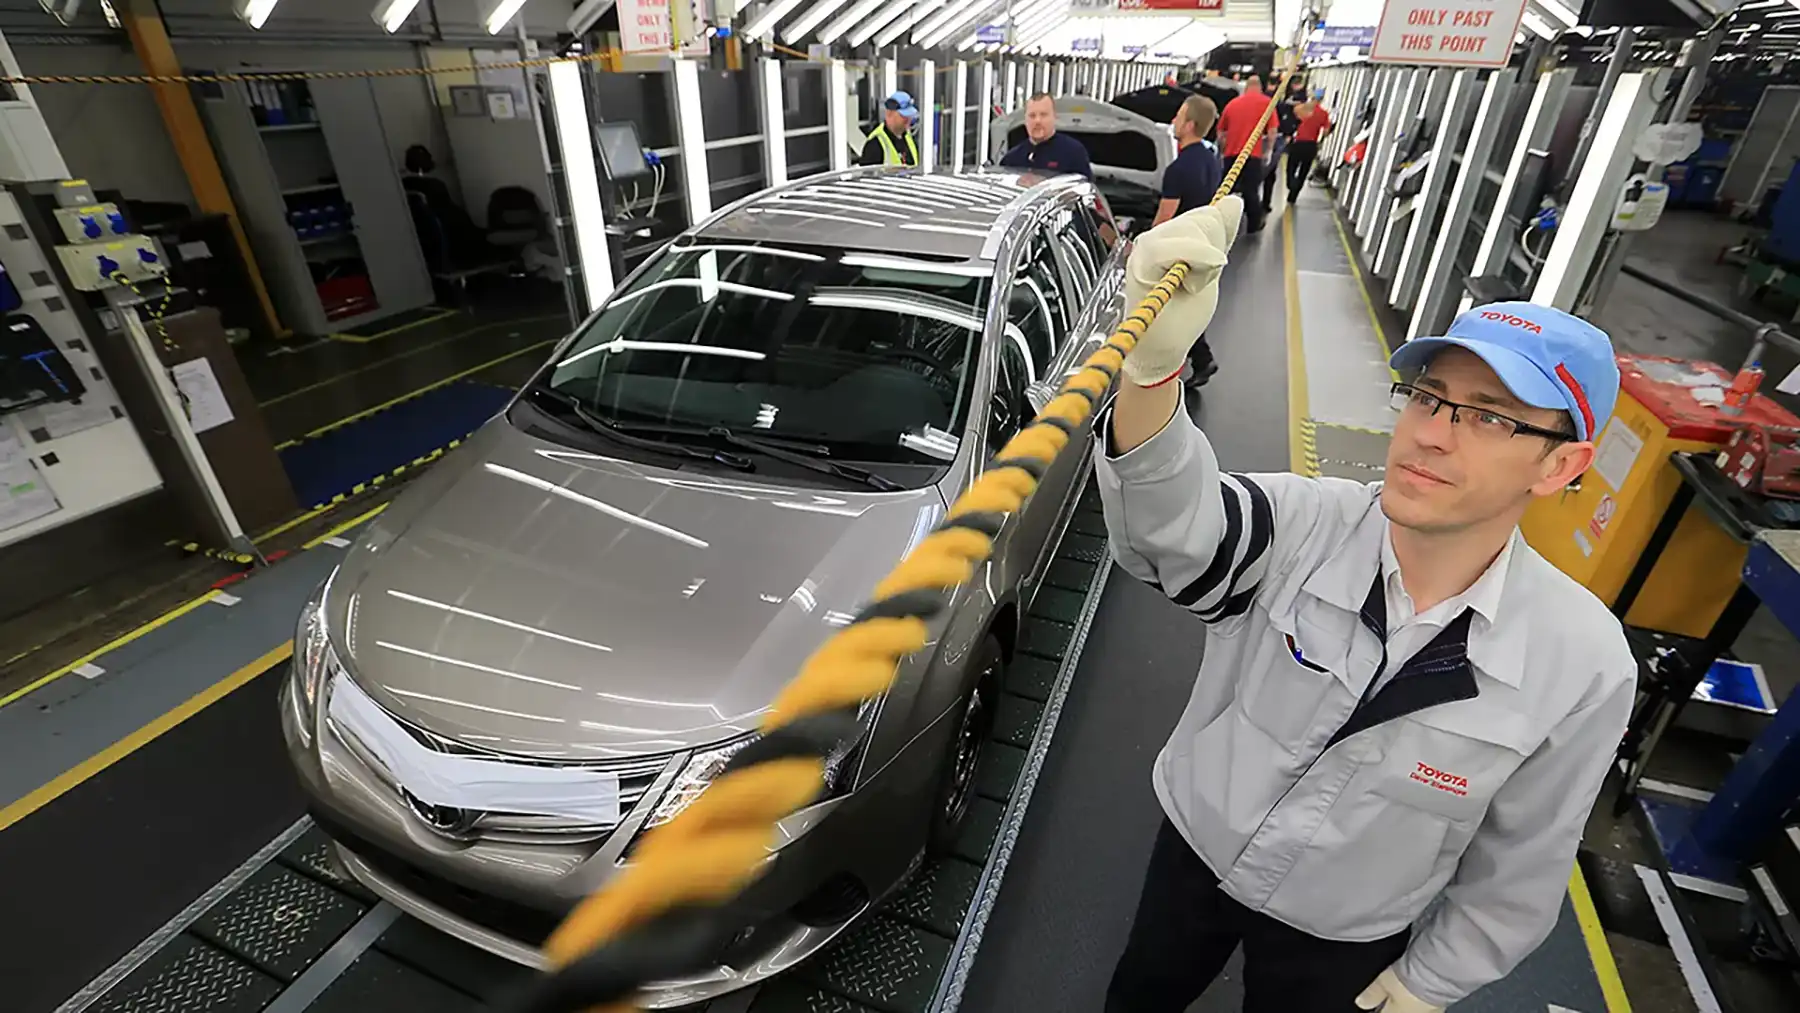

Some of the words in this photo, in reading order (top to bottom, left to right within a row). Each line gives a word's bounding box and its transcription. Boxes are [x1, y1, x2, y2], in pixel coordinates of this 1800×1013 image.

[637, 14, 660, 26] ONLY
[1407, 8, 1448, 26] ONLY
[1452, 9, 1494, 28] PAST
[638, 32, 659, 45] THIS
[1400, 34, 1434, 51] THIS
[1439, 35, 1488, 53] POINT
[1480, 311, 1542, 334] TOYOTA
[1417, 761, 1467, 788] TOYOTA
